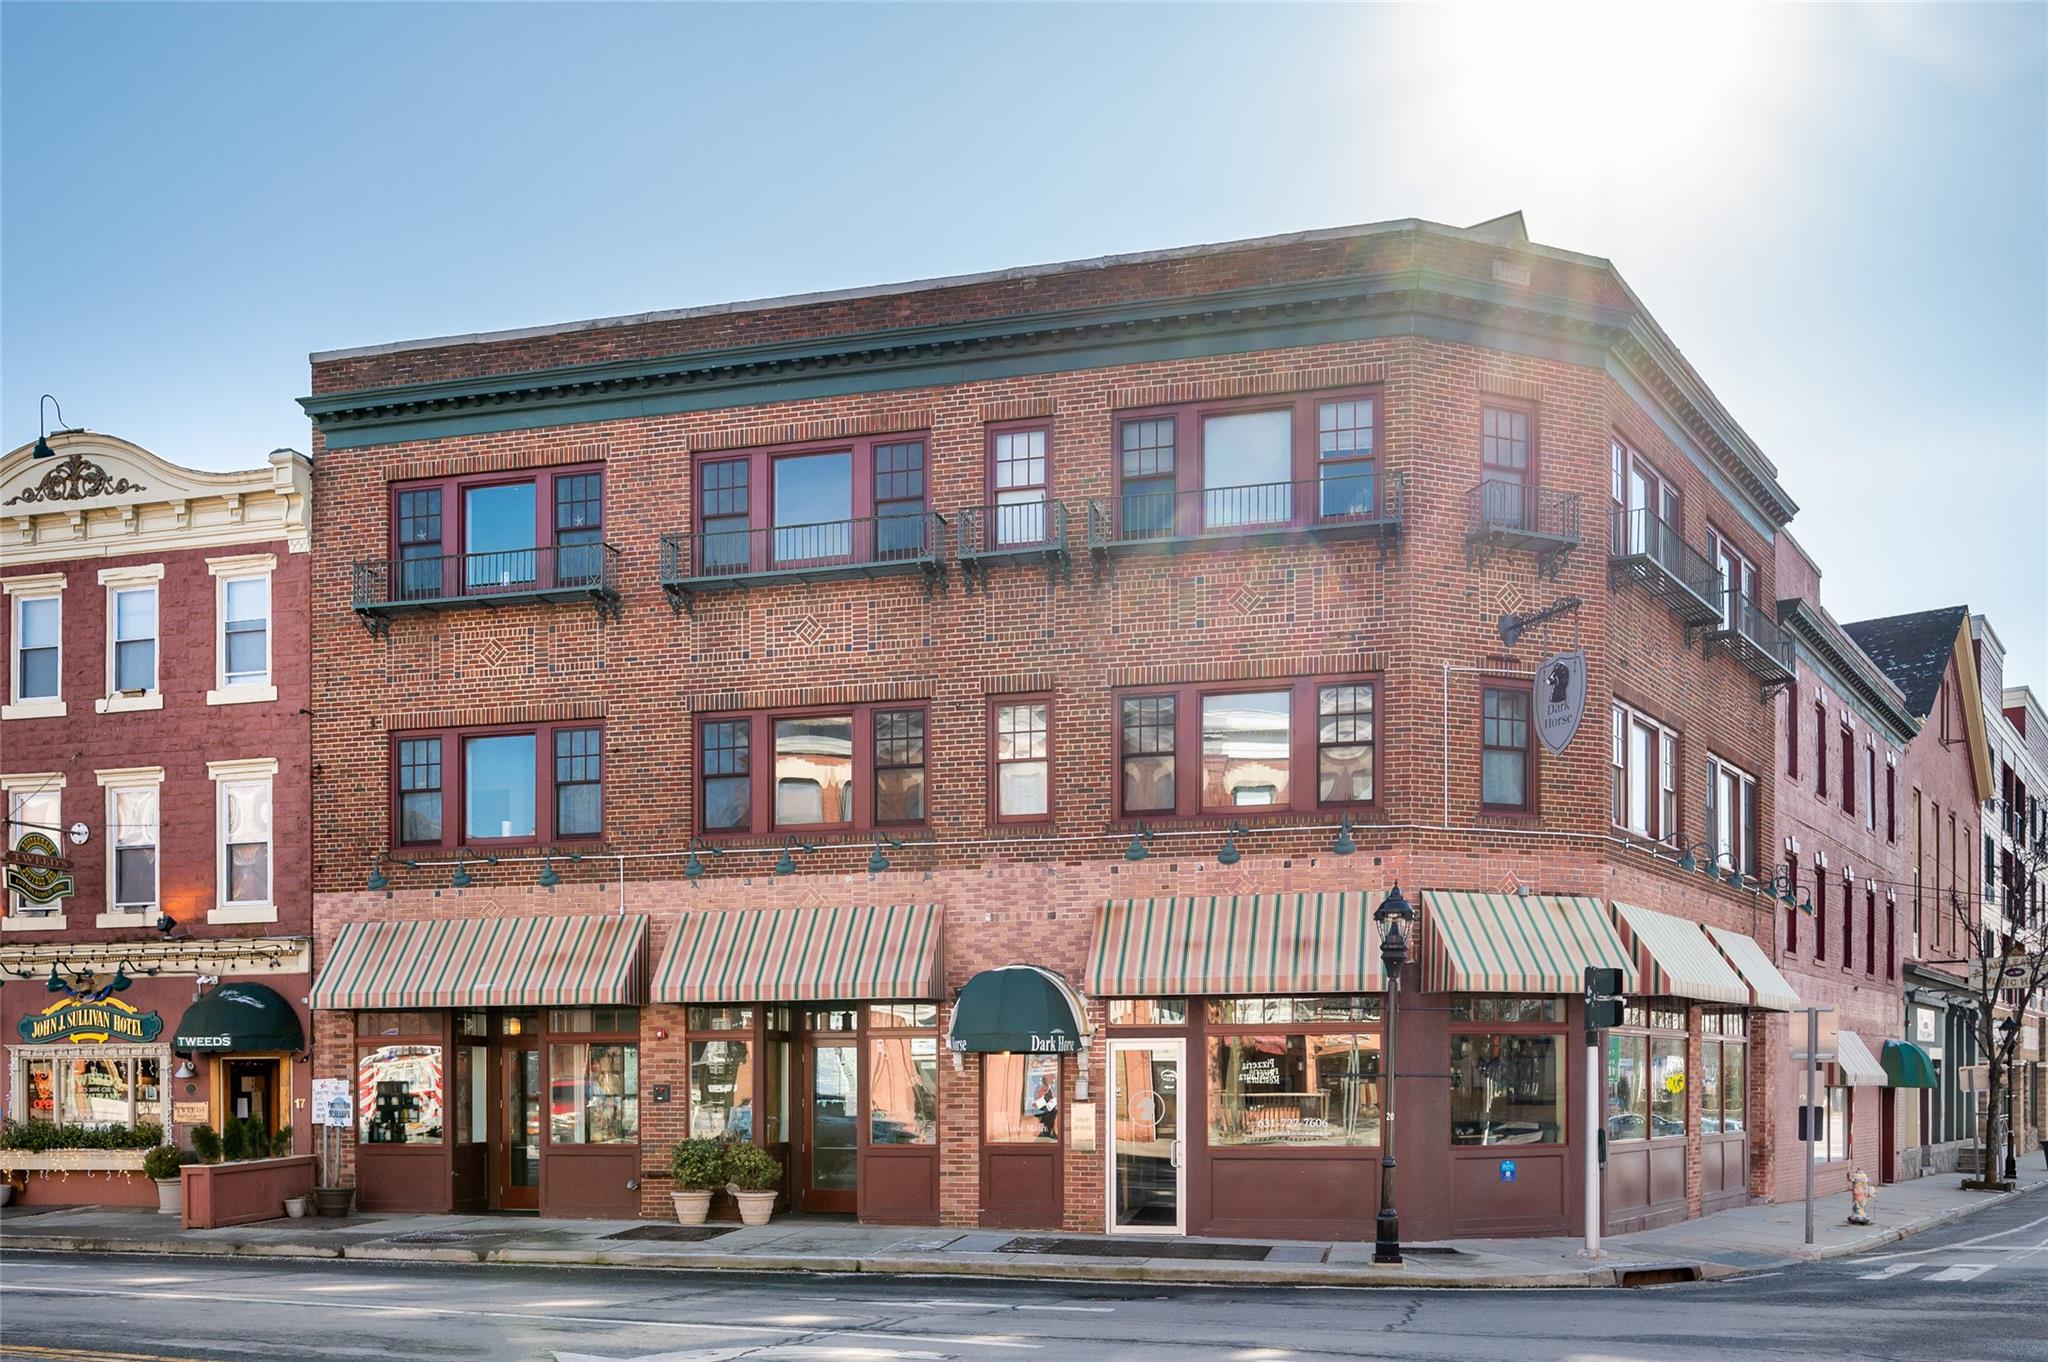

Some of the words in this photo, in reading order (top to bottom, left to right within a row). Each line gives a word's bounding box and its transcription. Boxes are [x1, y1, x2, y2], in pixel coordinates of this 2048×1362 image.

[1547, 702, 1570, 715] Dark
[1544, 714, 1573, 729] Horse
[31, 1016, 57, 1039] JOHN
[58, 1014, 66, 1031] J.
[66, 1009, 110, 1028] SULLIVAN
[113, 1014, 143, 1037] HOTEL
[177, 1036, 231, 1047] TWEEDS
[1031, 1034, 1056, 1051] Dark
[1057, 1035, 1075, 1051] Horse
[294, 1097, 306, 1109] 17
[1386, 1112, 1395, 1120] 20
[1257, 1118, 1328, 1128] 631-727-7606
